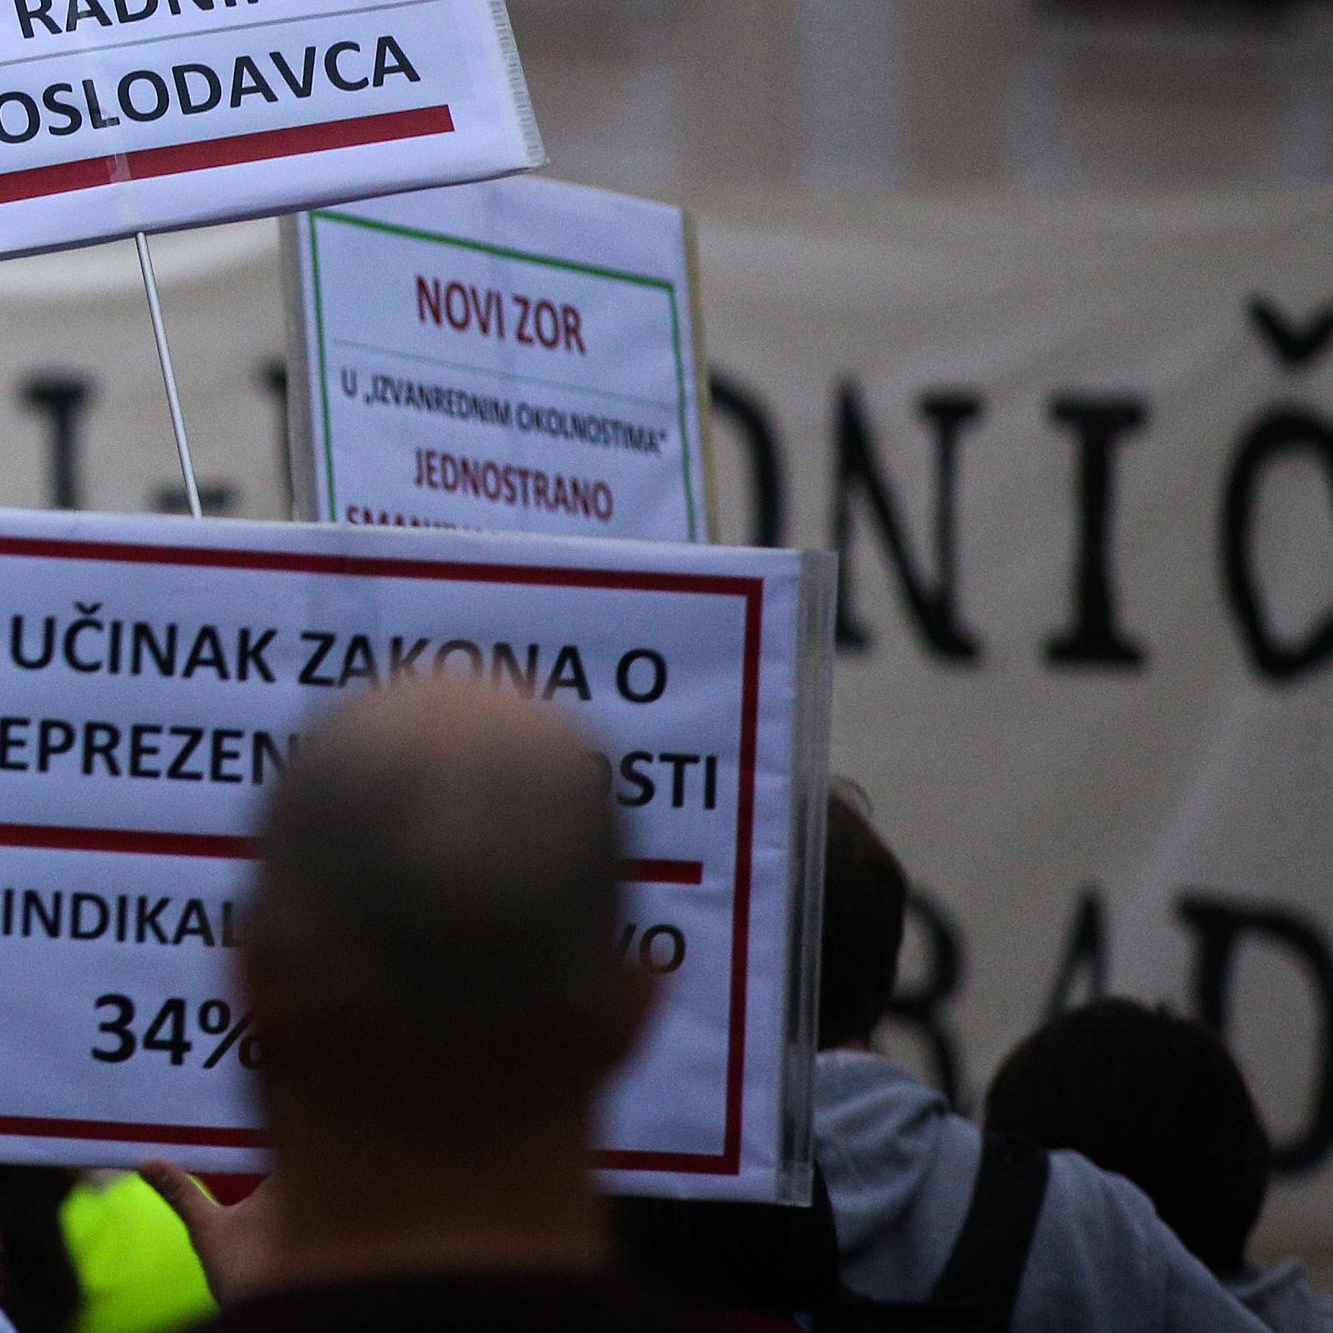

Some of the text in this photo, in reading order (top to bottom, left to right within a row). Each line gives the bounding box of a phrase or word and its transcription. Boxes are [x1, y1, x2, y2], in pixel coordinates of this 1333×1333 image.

[415, 274, 586, 356] NOVI ZOR
[340, 368, 357, 397] U
[414, 447, 614, 523] JEDNOSTRANO
[10, 601, 278, 684] UČINAK
[614, 646, 668, 705] O
